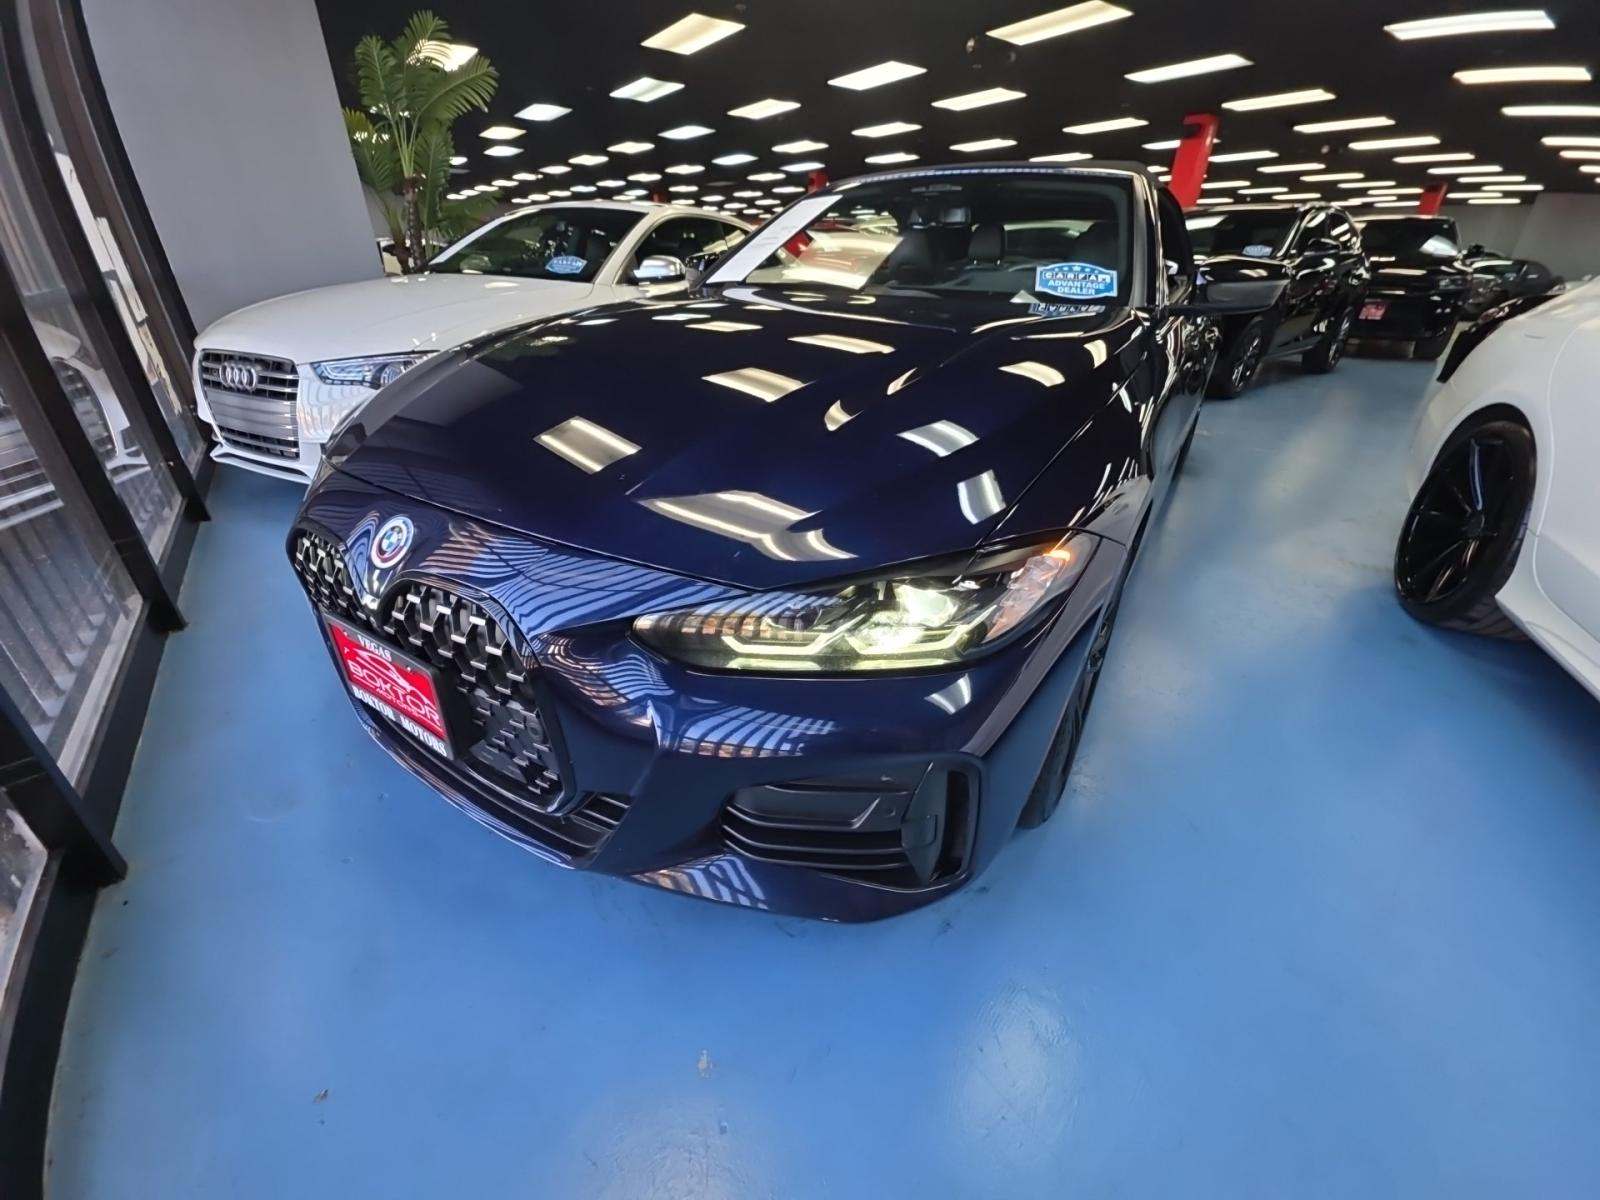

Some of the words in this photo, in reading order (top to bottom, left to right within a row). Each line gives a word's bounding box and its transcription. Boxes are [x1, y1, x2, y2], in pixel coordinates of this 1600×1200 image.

[1047, 279, 1105, 290] ADVANTAGE
[1057, 286, 1096, 295] DEALER
[357, 634, 392, 662] VEGAS
[347, 660, 441, 727] BOKTOR
[352, 685, 396, 722] BOKTOR
[400, 716, 448, 757] MOTORS
